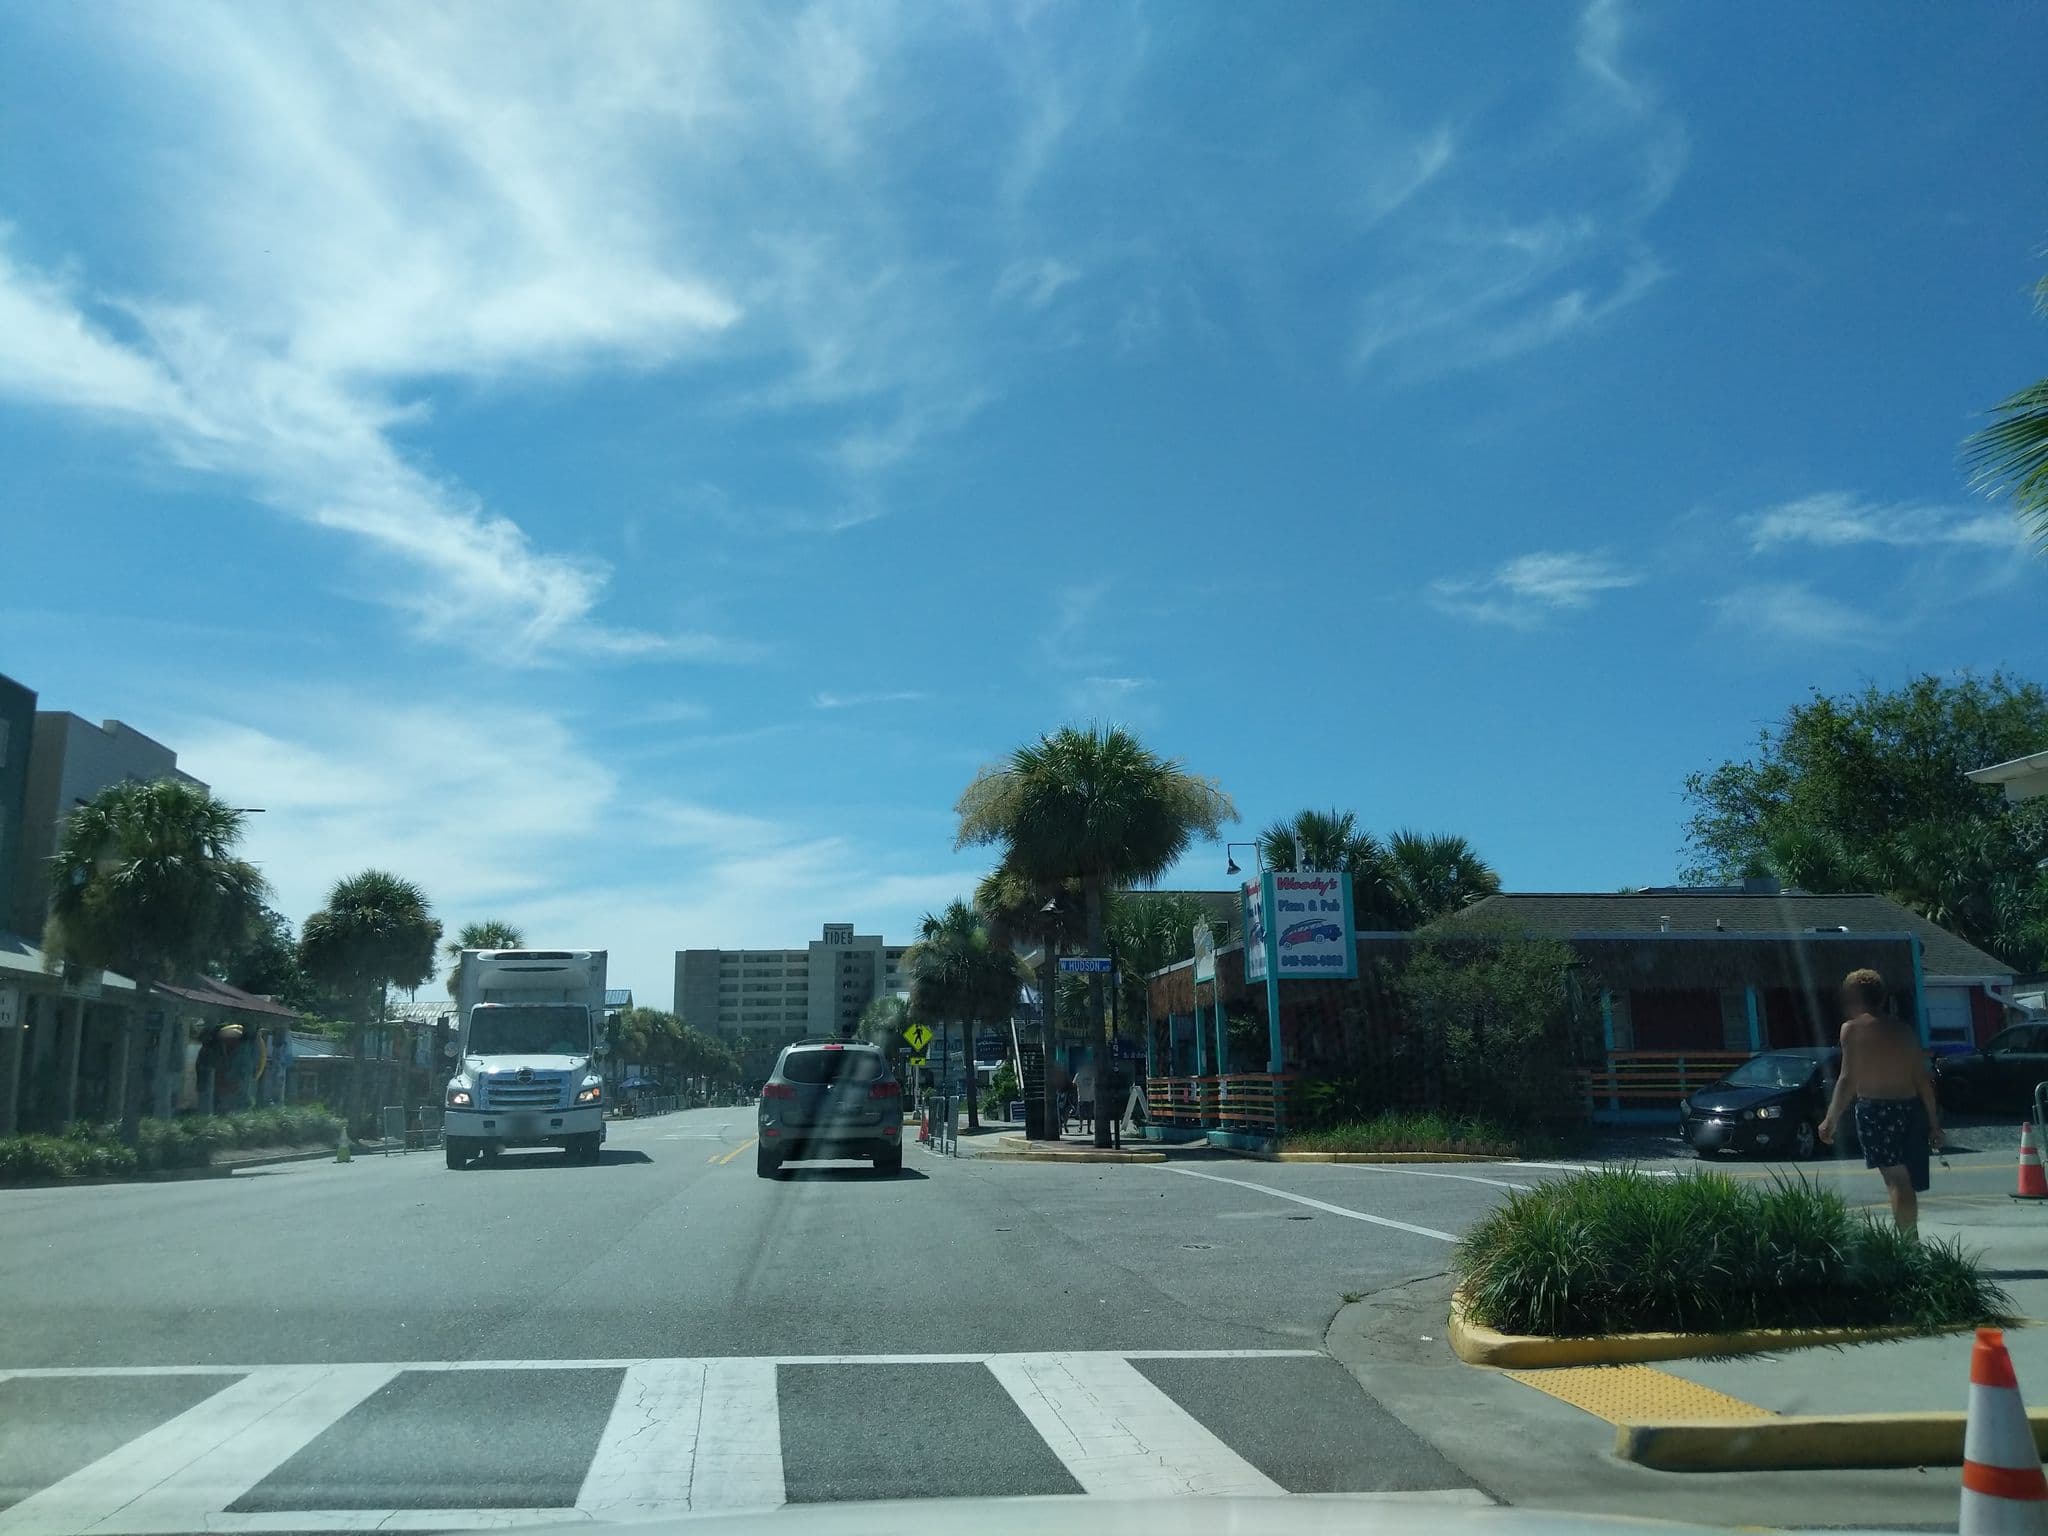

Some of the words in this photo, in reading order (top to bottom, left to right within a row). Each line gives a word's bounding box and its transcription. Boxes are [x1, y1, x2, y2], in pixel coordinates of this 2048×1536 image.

[1277, 876, 1338, 896] Woody's
[1308, 899, 1318, 912] &
[1320, 899, 1341, 912] Pub
[824, 932, 853, 945] TIDES
[1060, 960, 1067, 971] W
[1069, 960, 1100, 972] HUDSON
